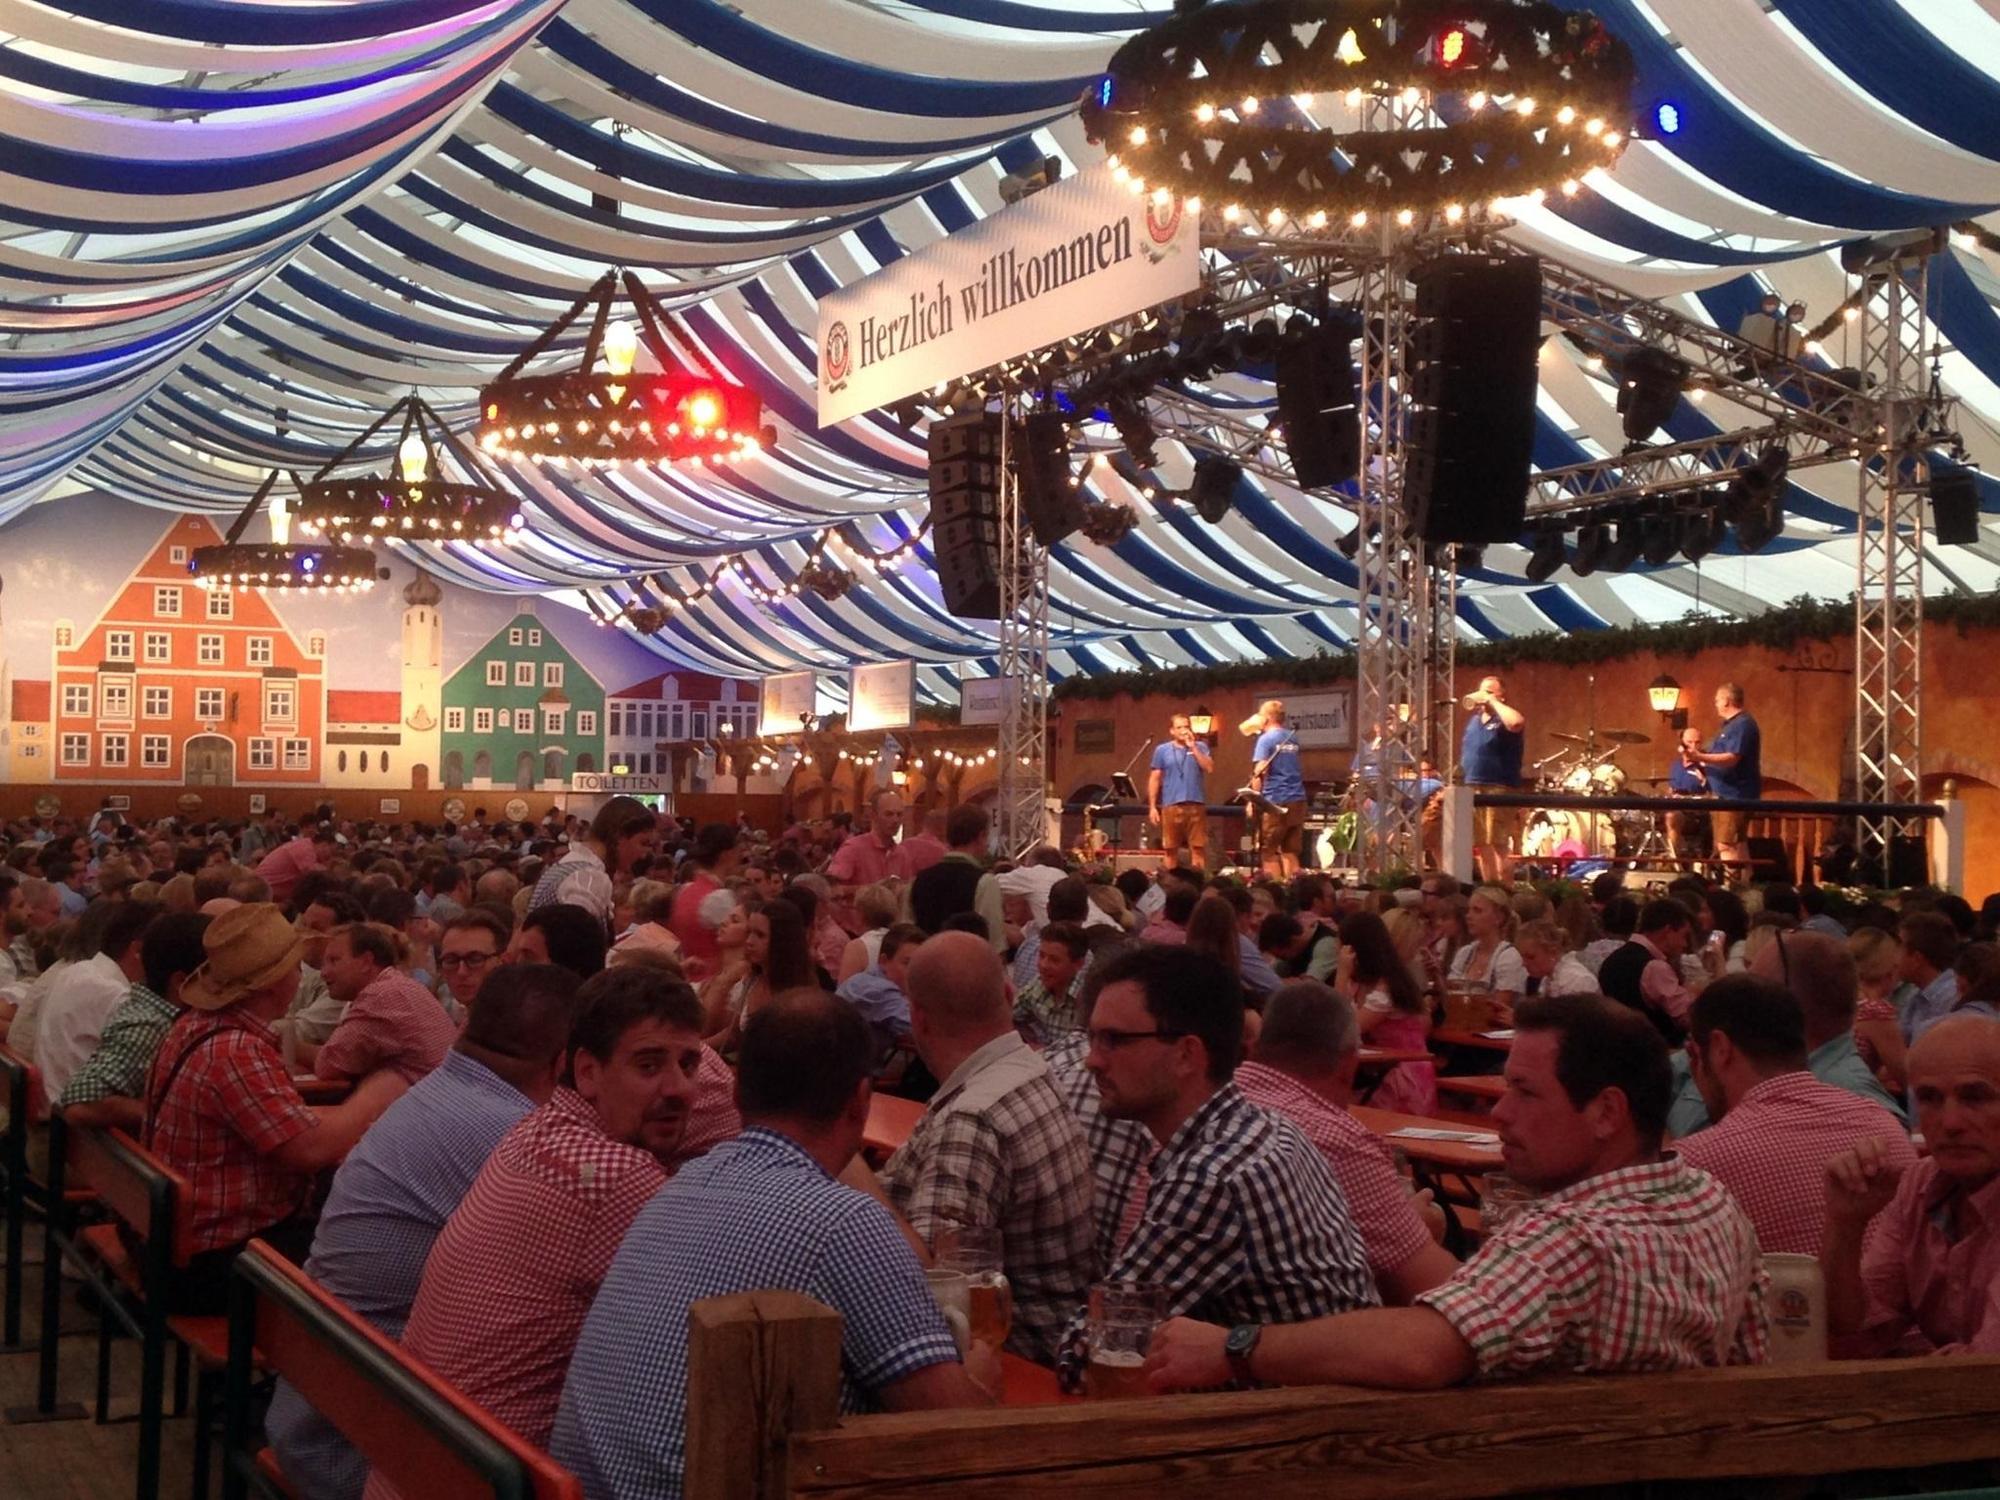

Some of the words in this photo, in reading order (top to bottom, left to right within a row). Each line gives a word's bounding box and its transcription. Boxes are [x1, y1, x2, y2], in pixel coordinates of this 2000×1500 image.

[859, 279, 954, 369] Herzlich
[960, 216, 1132, 325] willkommen
[576, 775, 660, 790] TOILETTEN
